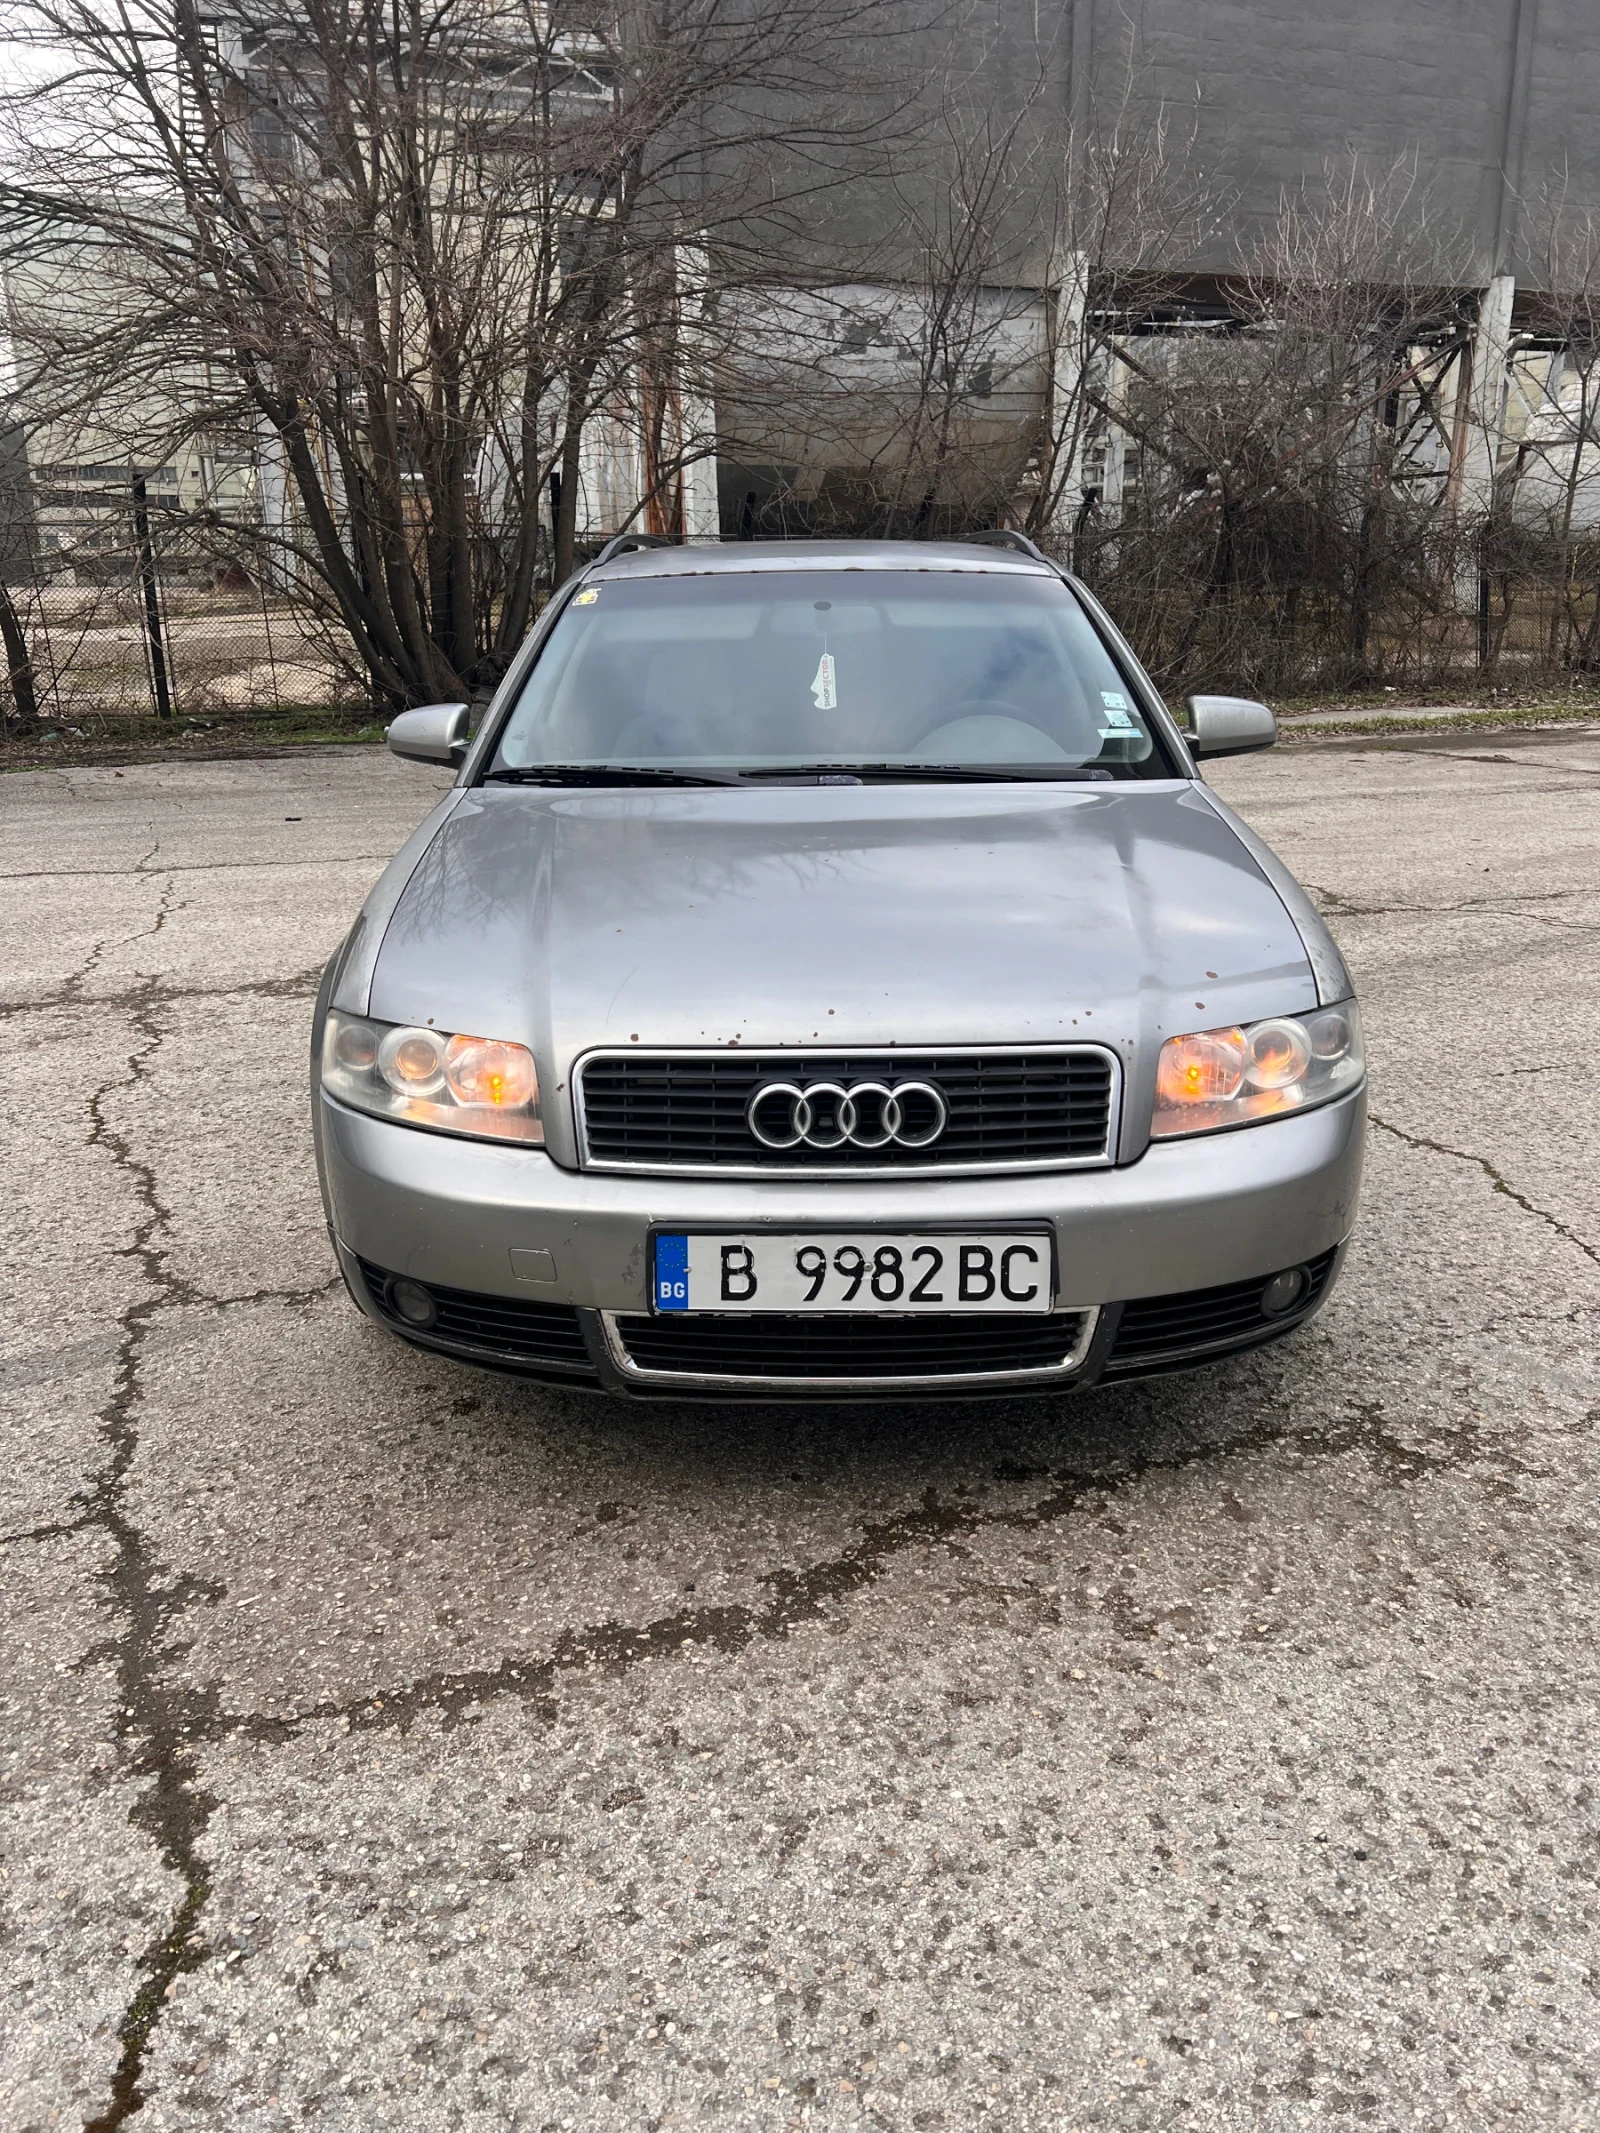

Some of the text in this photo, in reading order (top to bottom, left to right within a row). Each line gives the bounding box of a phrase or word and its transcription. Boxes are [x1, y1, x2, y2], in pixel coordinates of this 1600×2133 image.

[660, 1282, 685, 1298] BG
[721, 1245, 1038, 1302] B 9982 BC
